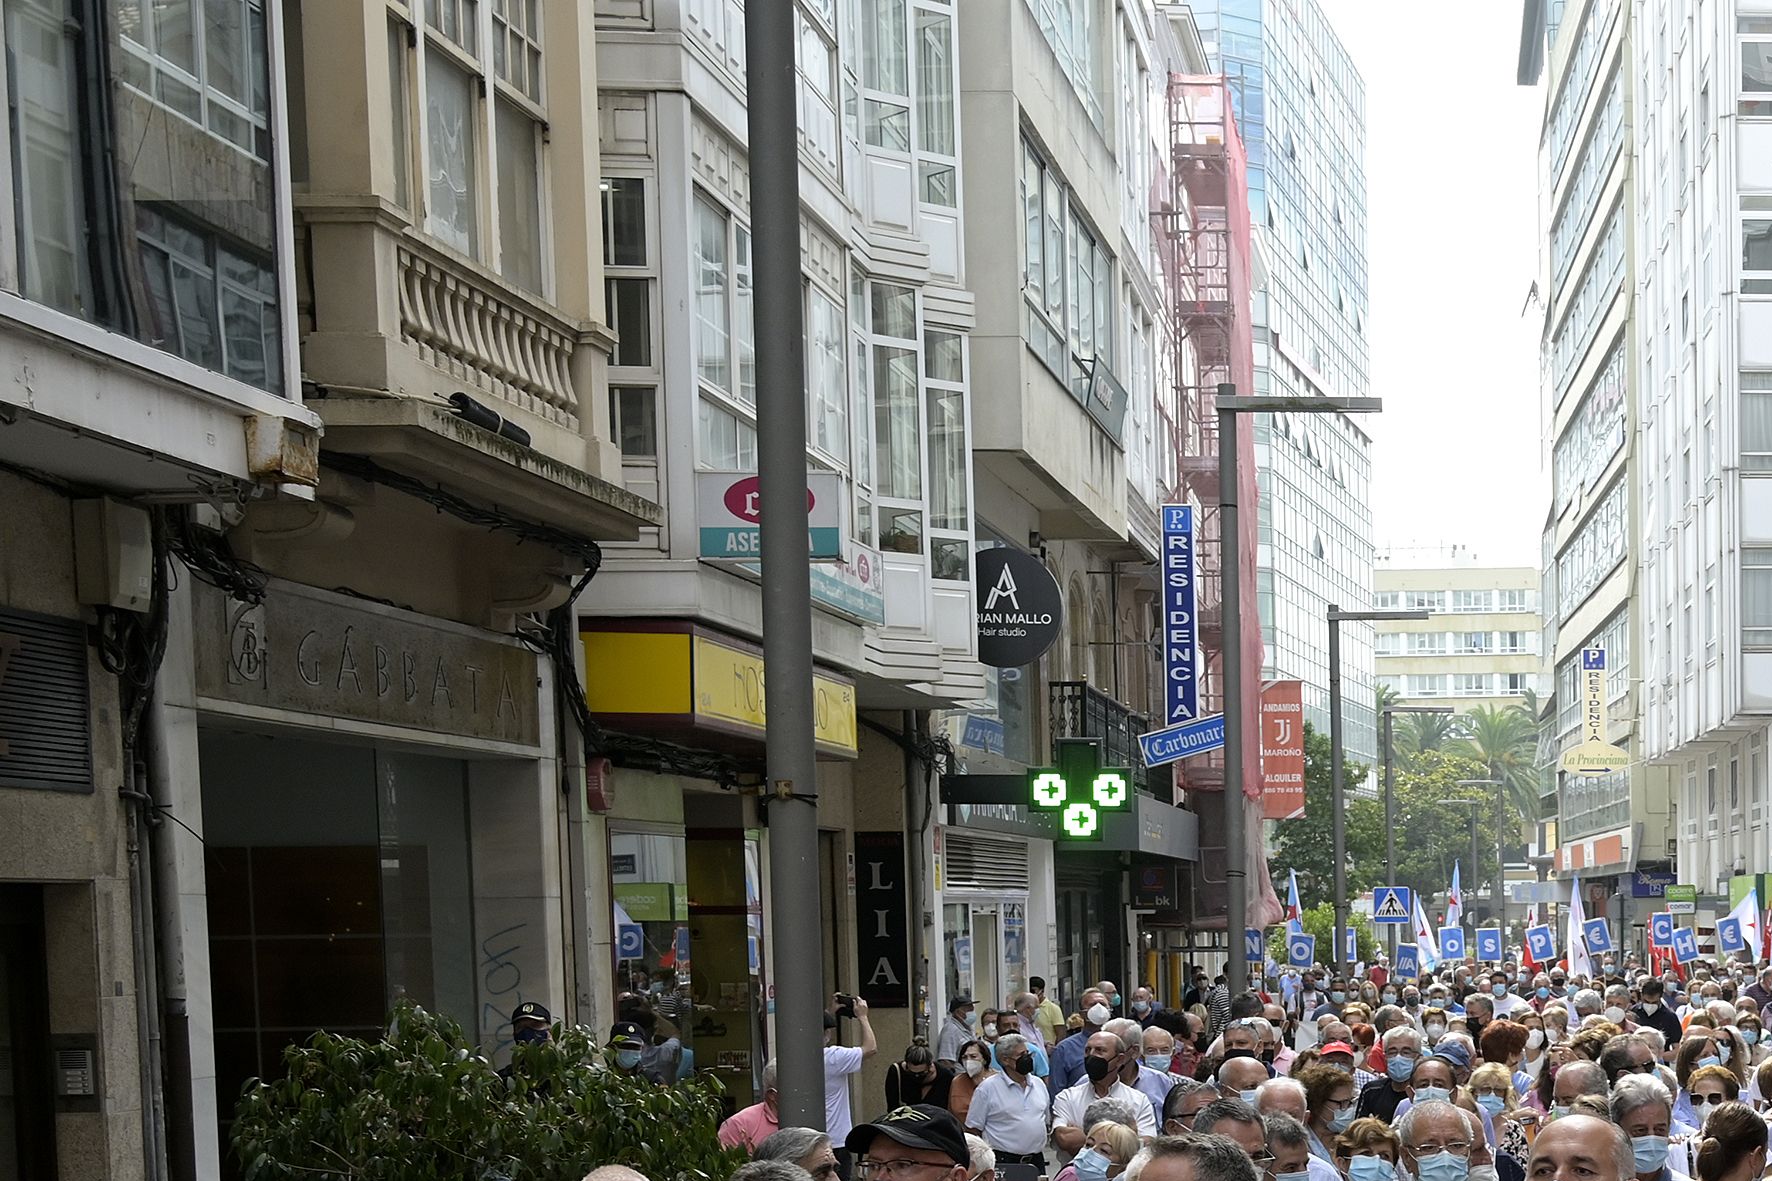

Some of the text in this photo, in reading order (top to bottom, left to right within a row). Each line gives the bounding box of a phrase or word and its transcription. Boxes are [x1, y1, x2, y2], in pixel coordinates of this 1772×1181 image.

[1006, 613, 1052, 625] MALLO
[1168, 536, 1193, 718] RESIDENCIA
[998, 628, 1027, 637] studio
[1589, 651, 1600, 662] P
[1263, 703, 1301, 712] ANDAMIOS
[1588, 672, 1601, 741] RESIDENCIA
[1264, 747, 1302, 757] MAROÑO
[1563, 753, 1575, 765] La
[1264, 773, 1302, 783] ALQUILER
[867, 862, 901, 985] LIA
[1654, 920, 1670, 940] C
[1245, 937, 1260, 954] N
[1290, 941, 1310, 960] O
[1483, 938, 1496, 953] S
[1530, 934, 1546, 953] P
[1676, 935, 1694, 955] H
